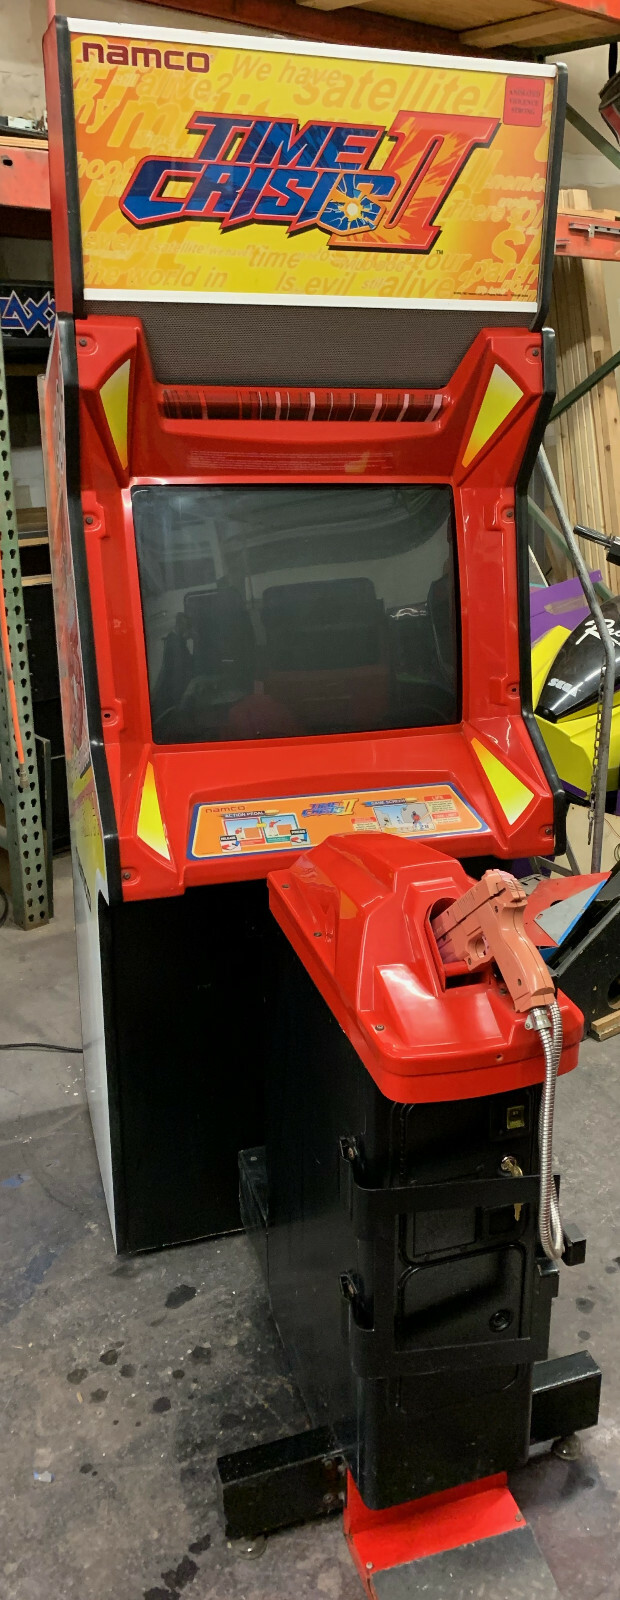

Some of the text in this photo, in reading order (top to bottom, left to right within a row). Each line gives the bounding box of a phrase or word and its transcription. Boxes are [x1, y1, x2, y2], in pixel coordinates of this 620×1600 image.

[81, 41, 210, 73] namco
[232, 54, 342, 87] We have
[293, 65, 502, 116] satellite!
[186, 111, 386, 170] TIME
[119, 155, 398, 236] CRISIS
[326, 109, 501, 249] II
[204, 267, 228, 287] in
[304, 271, 357, 295] evil
[205, 804, 246, 814] namco
